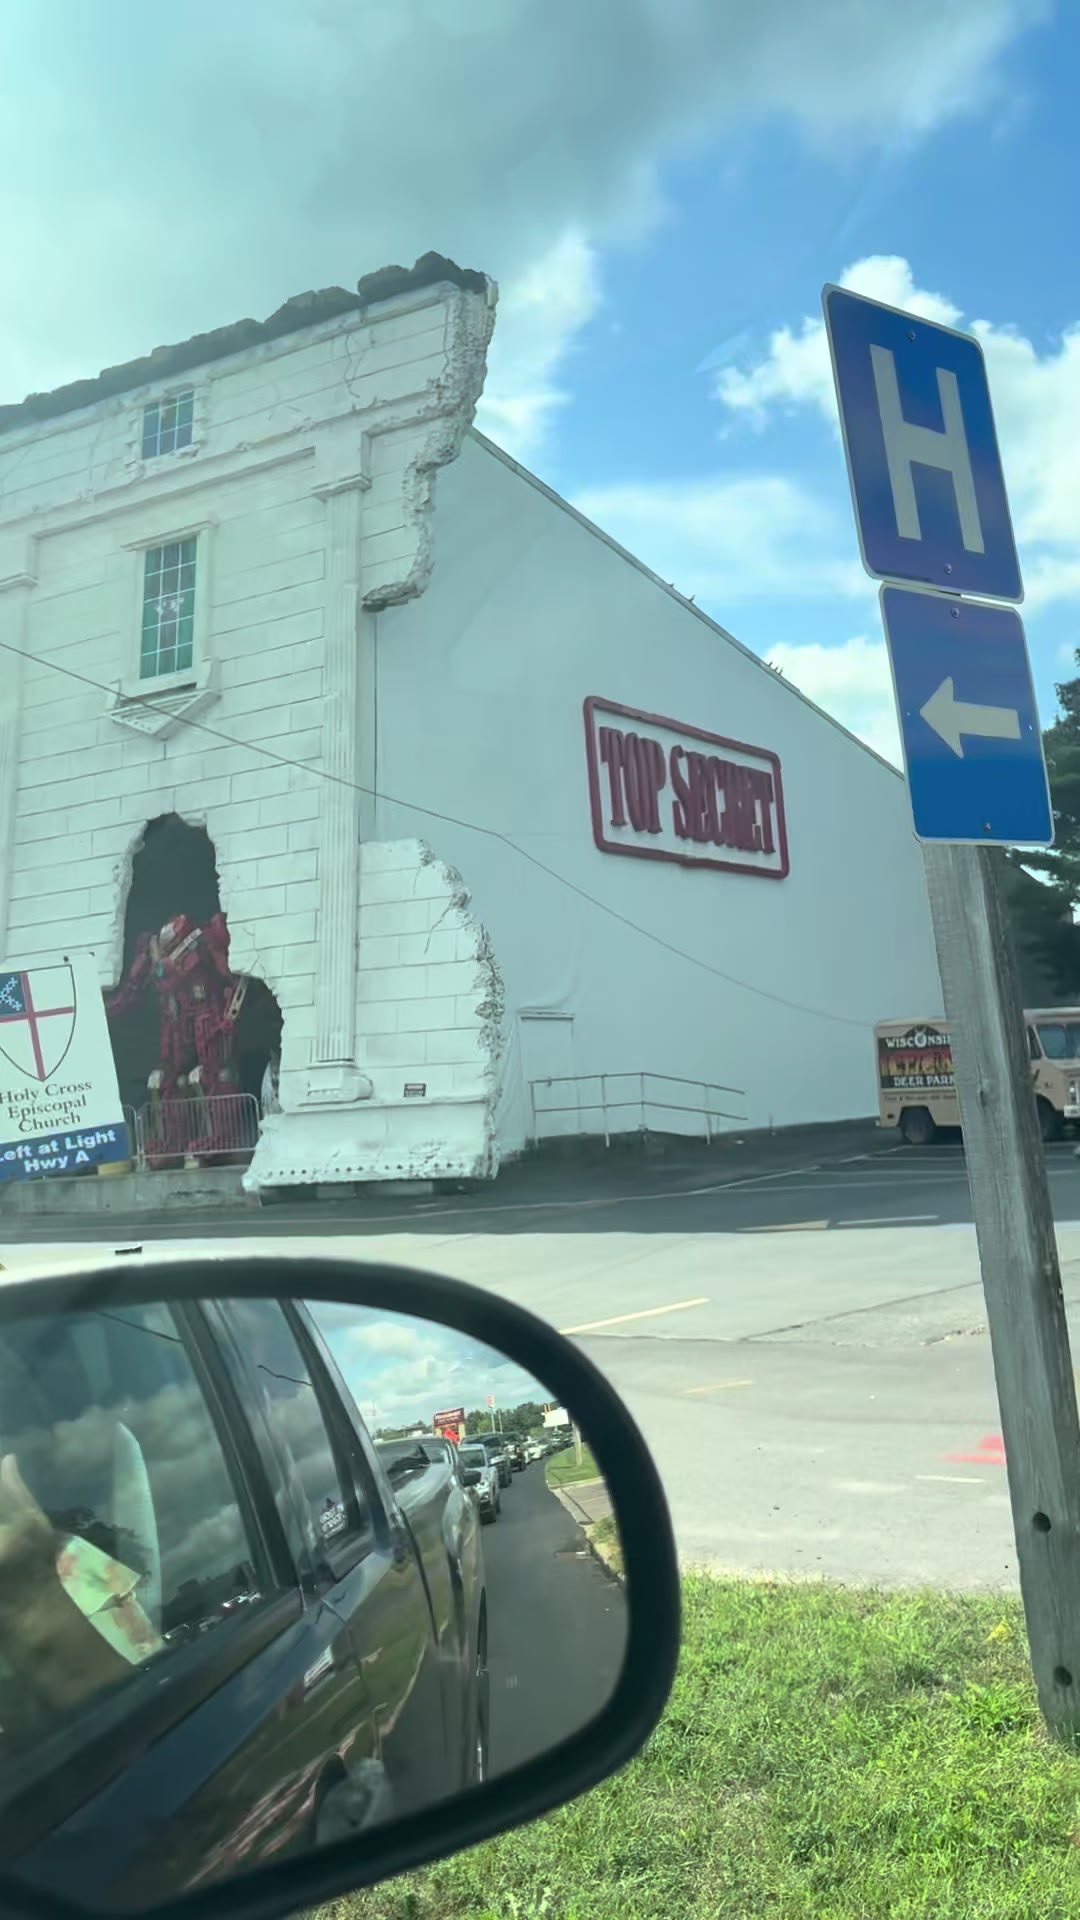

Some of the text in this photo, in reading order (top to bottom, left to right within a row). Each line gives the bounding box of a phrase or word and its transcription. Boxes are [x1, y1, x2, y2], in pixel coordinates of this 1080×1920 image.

[869, 343, 985, 554] H
[599, 726, 776, 855] TOP SECRET
[0, 1081, 92, 1104] Holy Cross
[894, 1076, 924, 1087] DEER
[8, 1094, 87, 1120] Episcopal
[18, 1111, 81, 1132] Church
[38, 1140, 59, 1155] at
[64, 1129, 116, 1150] Light
[24, 1150, 90, 1172] Hwy A
